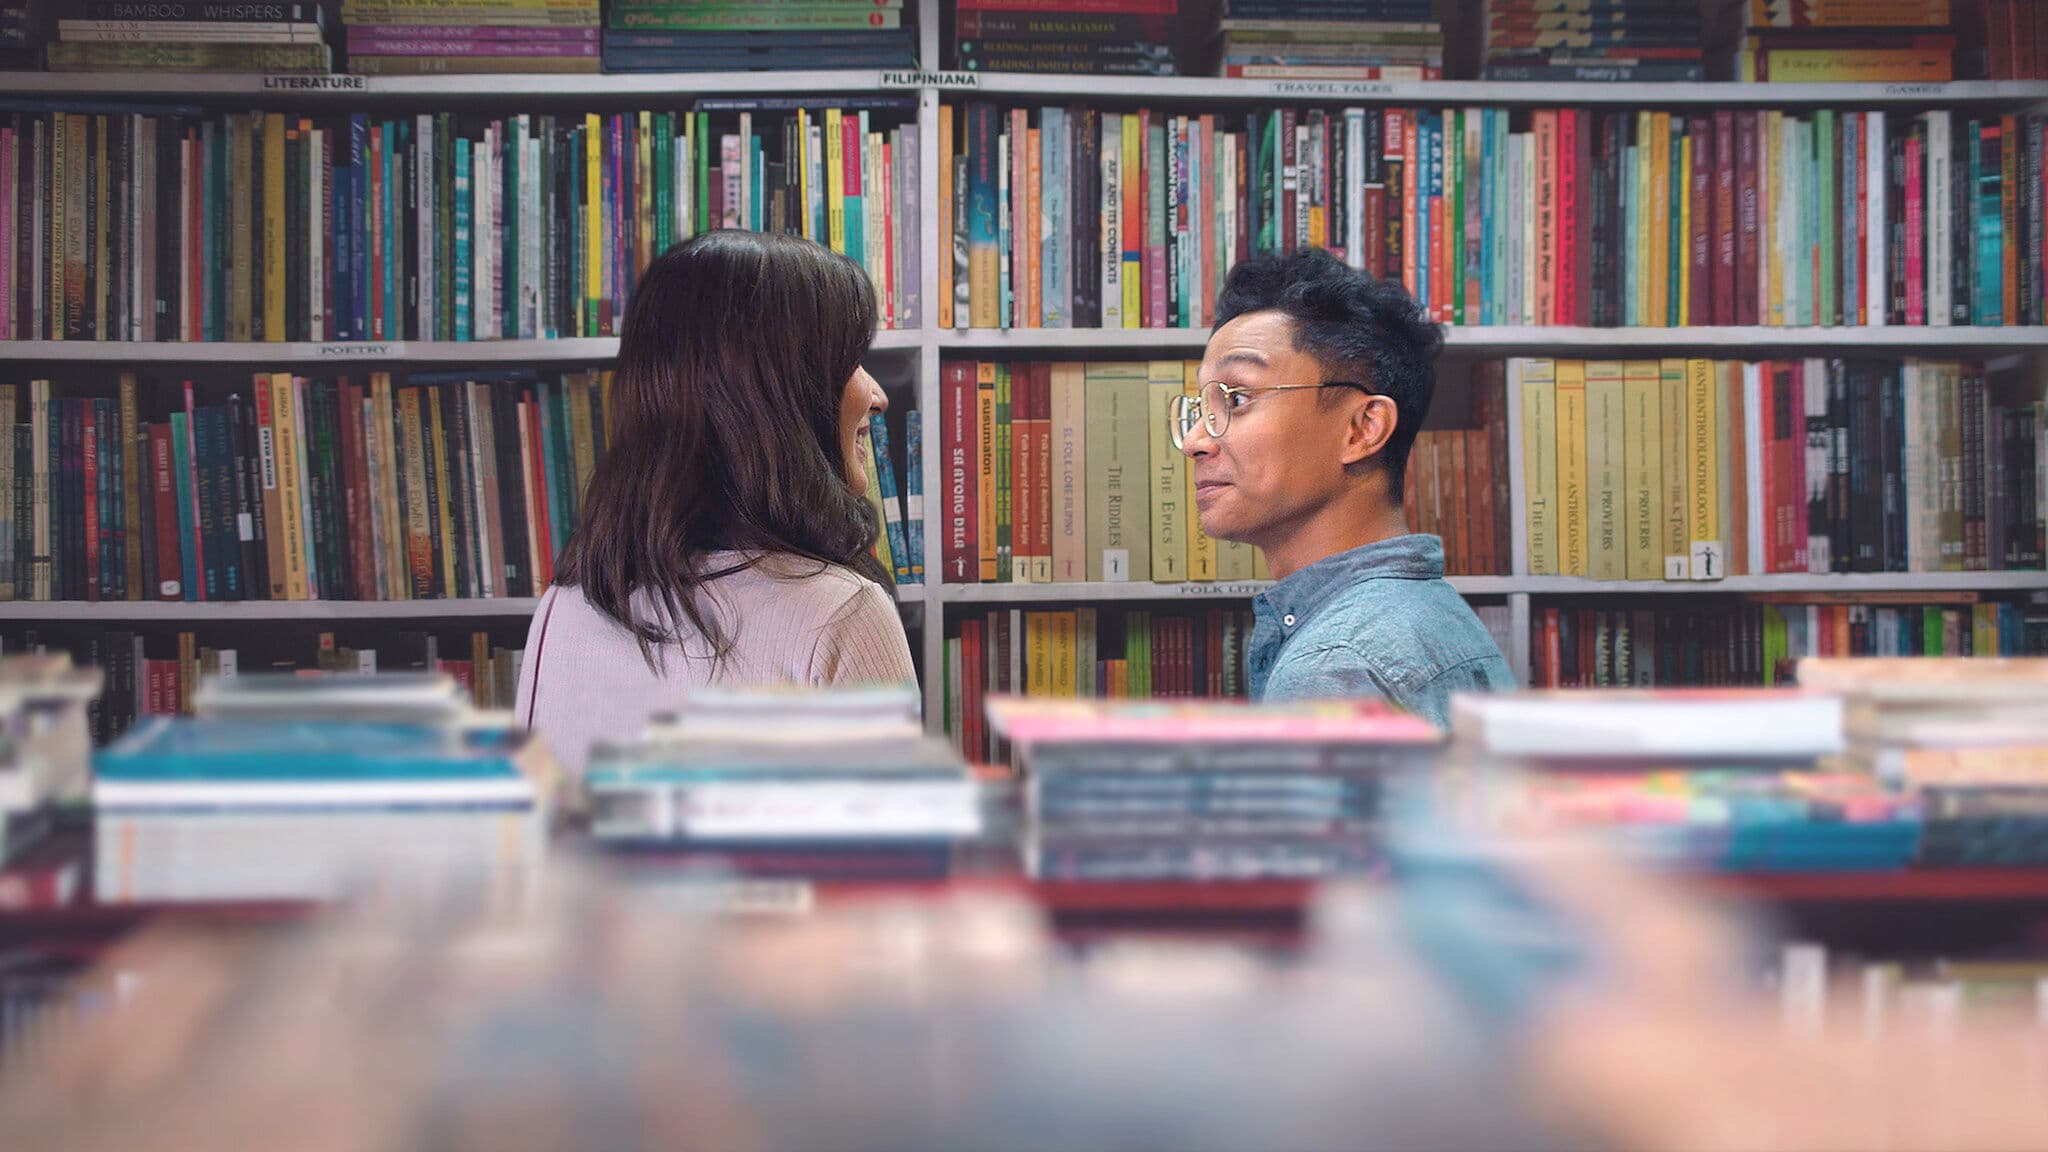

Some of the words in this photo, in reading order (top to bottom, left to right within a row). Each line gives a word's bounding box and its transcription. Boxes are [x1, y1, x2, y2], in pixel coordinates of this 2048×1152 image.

[113, 4, 186, 18] BAMBOO
[203, 4, 283, 20] WHISPERS
[1071, 60, 1095, 71] OUT
[263, 77, 364, 89] LITERATURE
[883, 72, 977, 86] FILIPINIANA
[1274, 82, 1336, 93] TRAVEL
[1343, 82, 1393, 93] TALES
[1167, 119, 1177, 184] BASAGAN
[1106, 182, 1118, 207] AND
[1167, 185, 1177, 207] NG
[1538, 181, 1551, 207] Why
[1106, 209, 1118, 225] ITS
[1167, 207, 1177, 237] TRIP
[1541, 209, 1551, 228] We
[1541, 231, 1551, 251] Are
[1106, 226, 1118, 286] CONTEXTS
[1541, 254, 1551, 282] Poor
[321, 347, 388, 355] POETRY
[982, 398, 993, 475] susumaton
[1019, 433, 1030, 451] Folk
[1039, 433, 1049, 451] Folk
[1063, 427, 1074, 438] EL
[1019, 452, 1030, 478] Poetry
[1039, 452, 1049, 478] Poetry
[1107, 465, 1124, 490] THE
[1160, 463, 1175, 495] THE
[1063, 496, 1074, 537] FILIPINO
[1107, 494, 1124, 547] RIDDLES
[1160, 501, 1175, 545] EPICS
[1601, 489, 1613, 551] PROVERBS
[1638, 489, 1649, 550] PROVERBS
[1180, 585, 1223, 594] FOLK
